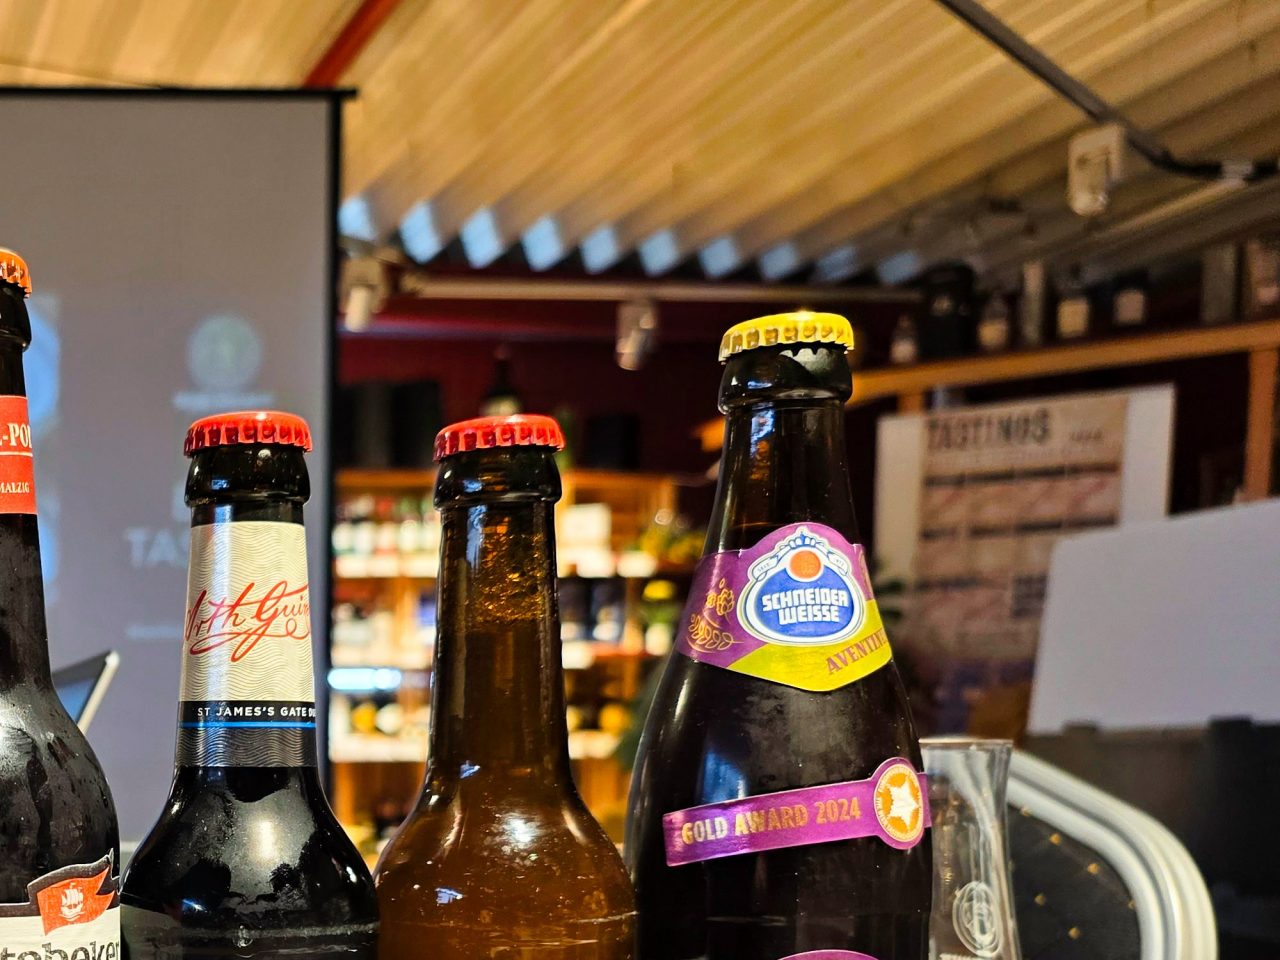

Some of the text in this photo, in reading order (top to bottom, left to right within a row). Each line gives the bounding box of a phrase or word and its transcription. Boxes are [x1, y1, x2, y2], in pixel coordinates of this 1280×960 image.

[761, 588, 849, 612] SCHNEIDER
[778, 606, 840, 625] WEISSE
[197, 707, 211, 717] ST
[215, 706, 275, 717] JAMES'S
[280, 706, 307, 717] GATE
[682, 797, 862, 845] GOLD AWARD 2024
